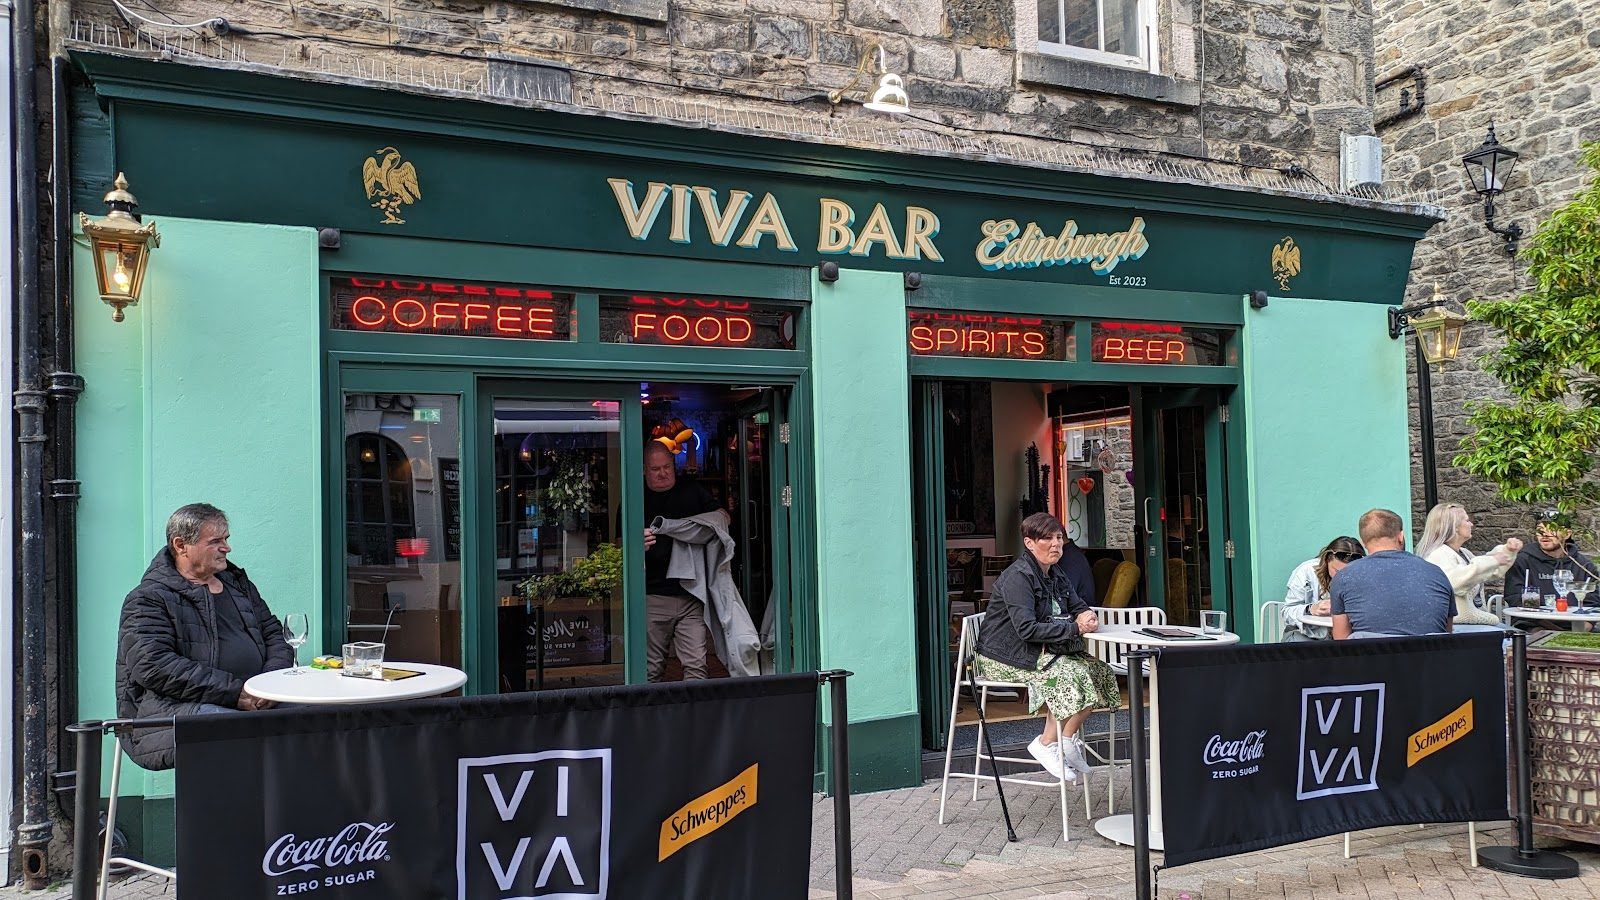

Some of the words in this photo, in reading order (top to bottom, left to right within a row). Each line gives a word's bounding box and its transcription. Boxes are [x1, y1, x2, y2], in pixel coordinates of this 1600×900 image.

[607, 177, 798, 252] VIVA
[817, 198, 944, 262] BAR
[975, 216, 1149, 276] Edinburgh
[1109, 275, 1121, 286] Est
[1124, 276, 1147, 287] 2023
[352, 296, 554, 334] COFFEE
[634, 313, 752, 342] FOOD
[909, 326, 1045, 356] SPIRITS
[1103, 338, 1185, 363] BEER
[1203, 729, 1267, 765] Coca-Cola
[1413, 714, 1467, 753] Schweppes
[1212, 770, 1237, 779] ZERO
[1239, 765, 1259, 776] SUGAR
[669, 784, 746, 841] Schweppes
[262, 822, 396, 876] Coca-Cola
[277, 880, 319, 895] ZERO
[324, 870, 376, 887] SUGAR
